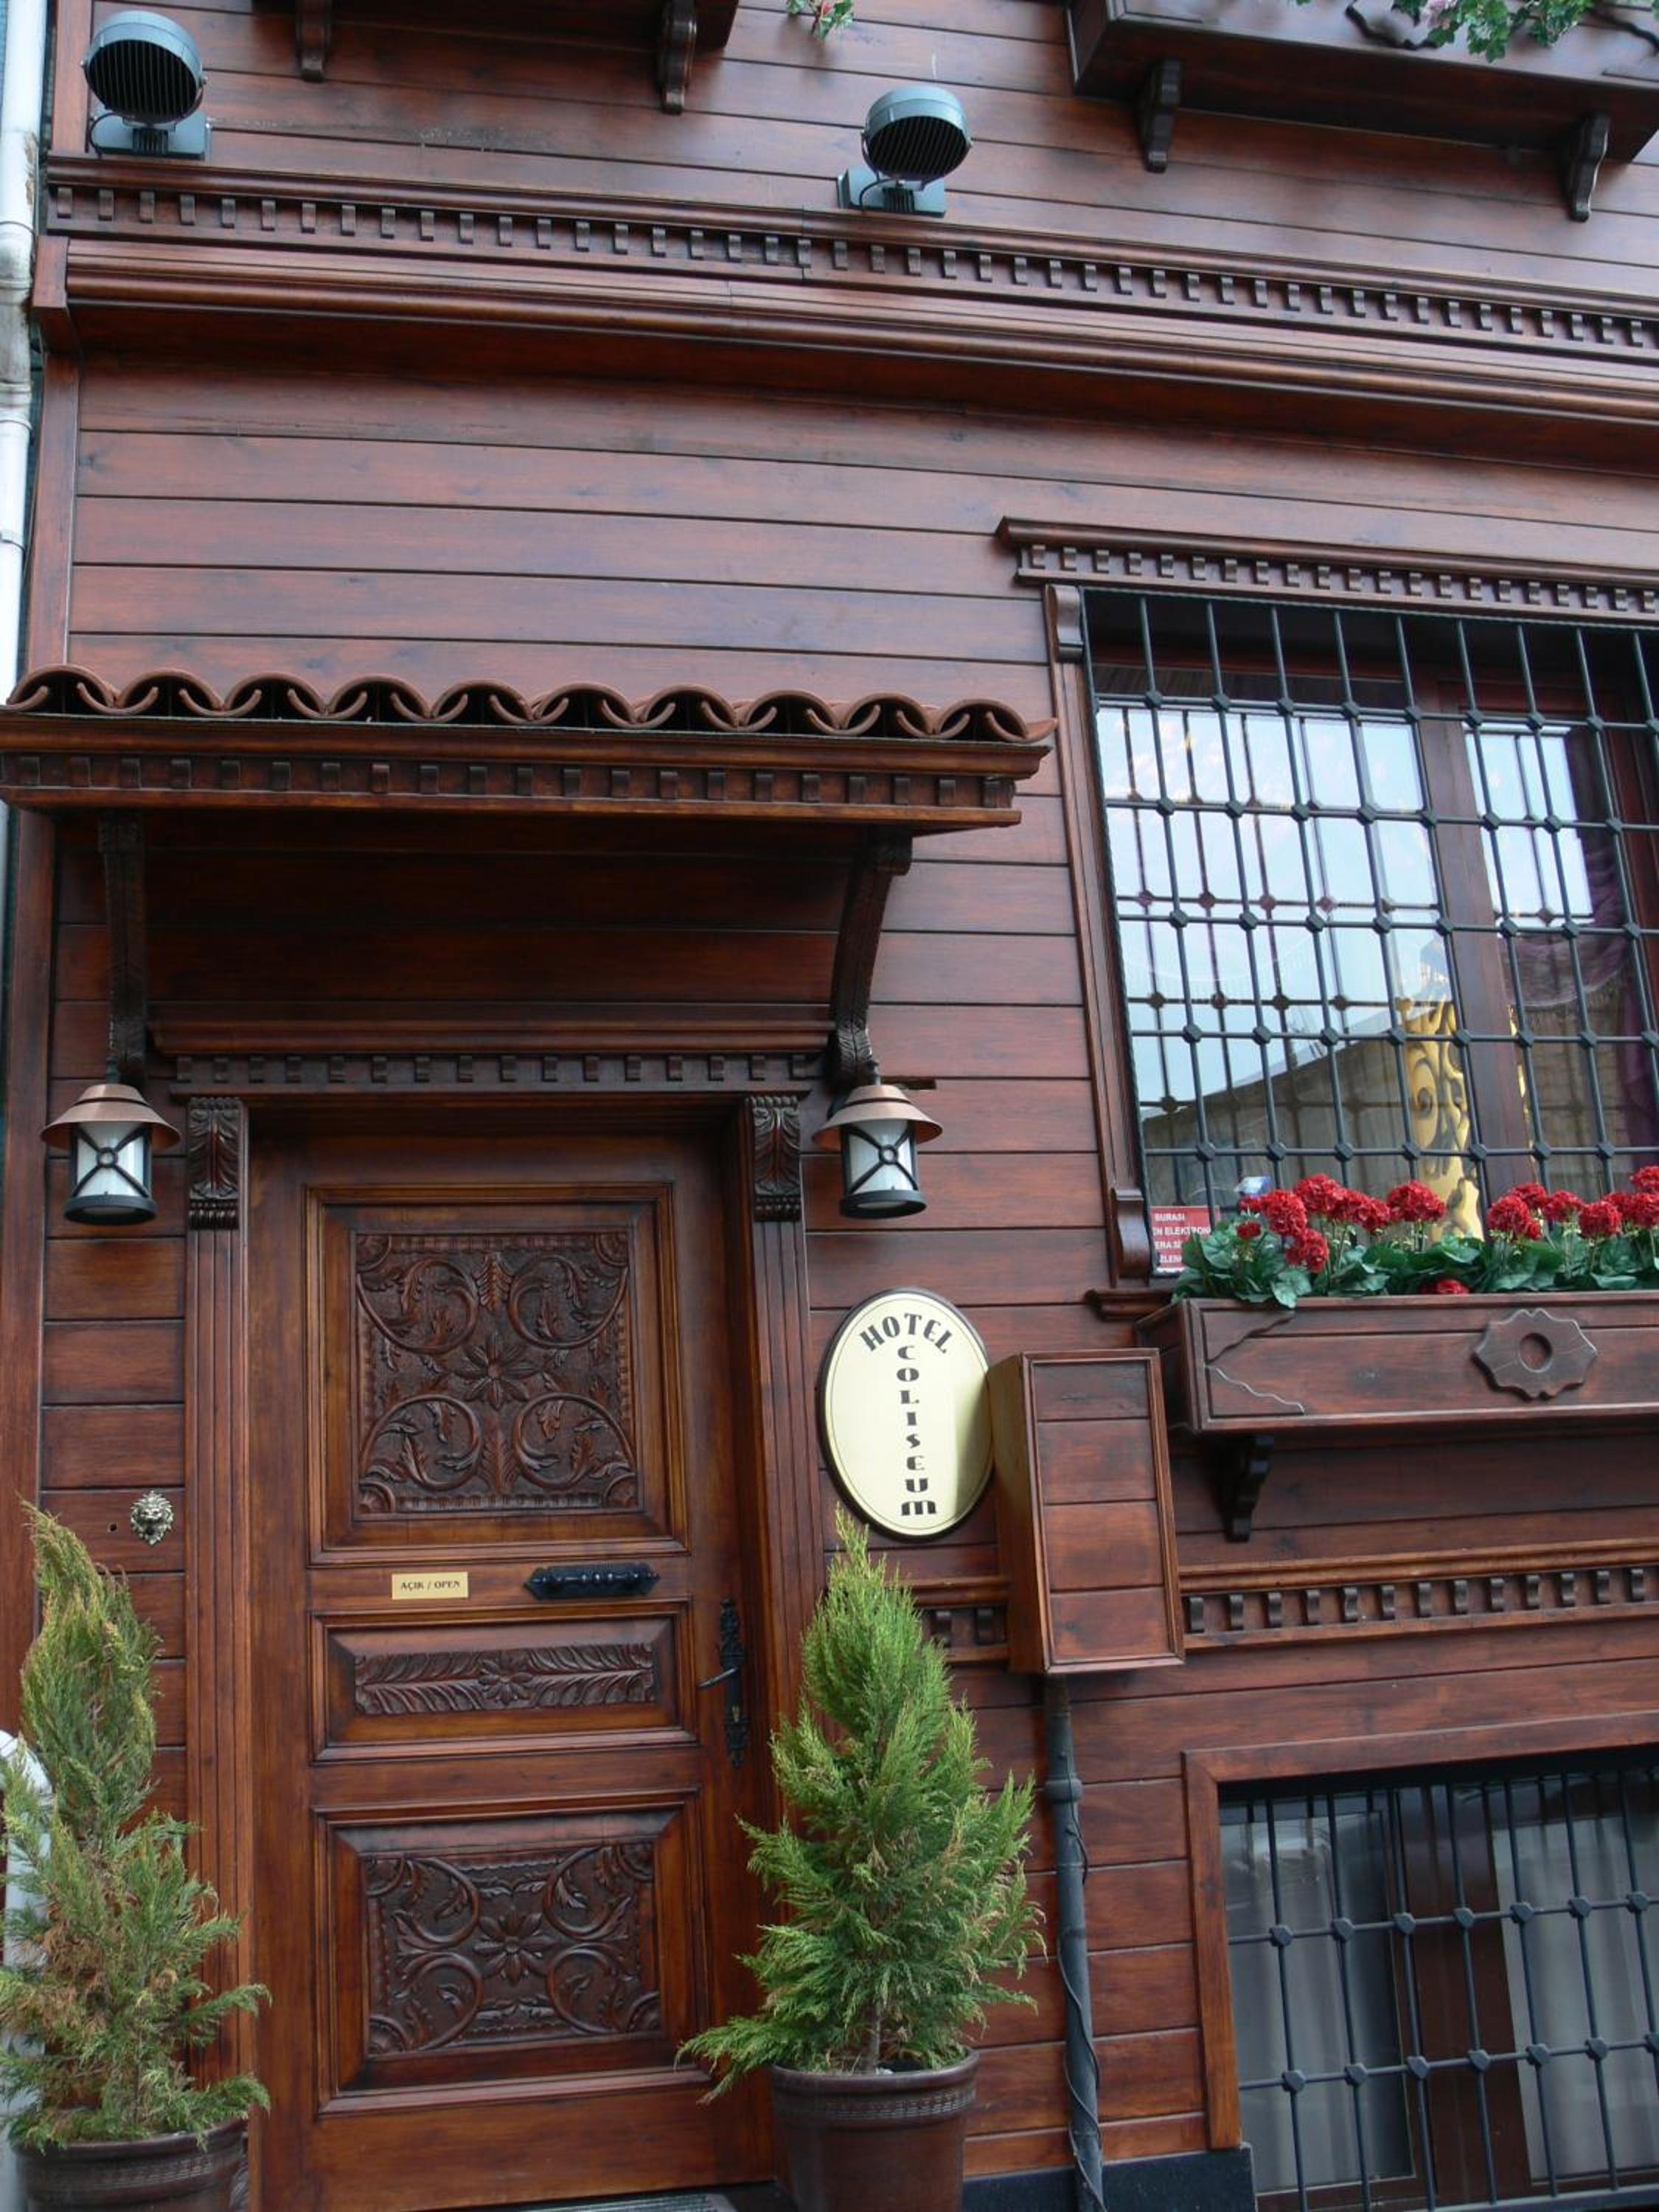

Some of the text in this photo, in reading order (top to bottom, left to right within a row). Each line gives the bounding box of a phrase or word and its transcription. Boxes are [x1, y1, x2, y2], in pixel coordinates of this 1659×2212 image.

[859, 1313, 953, 1354] HOTEL
[897, 1346, 936, 1517] COLISEUM
[434, 1580, 460, 1589] OPEN
